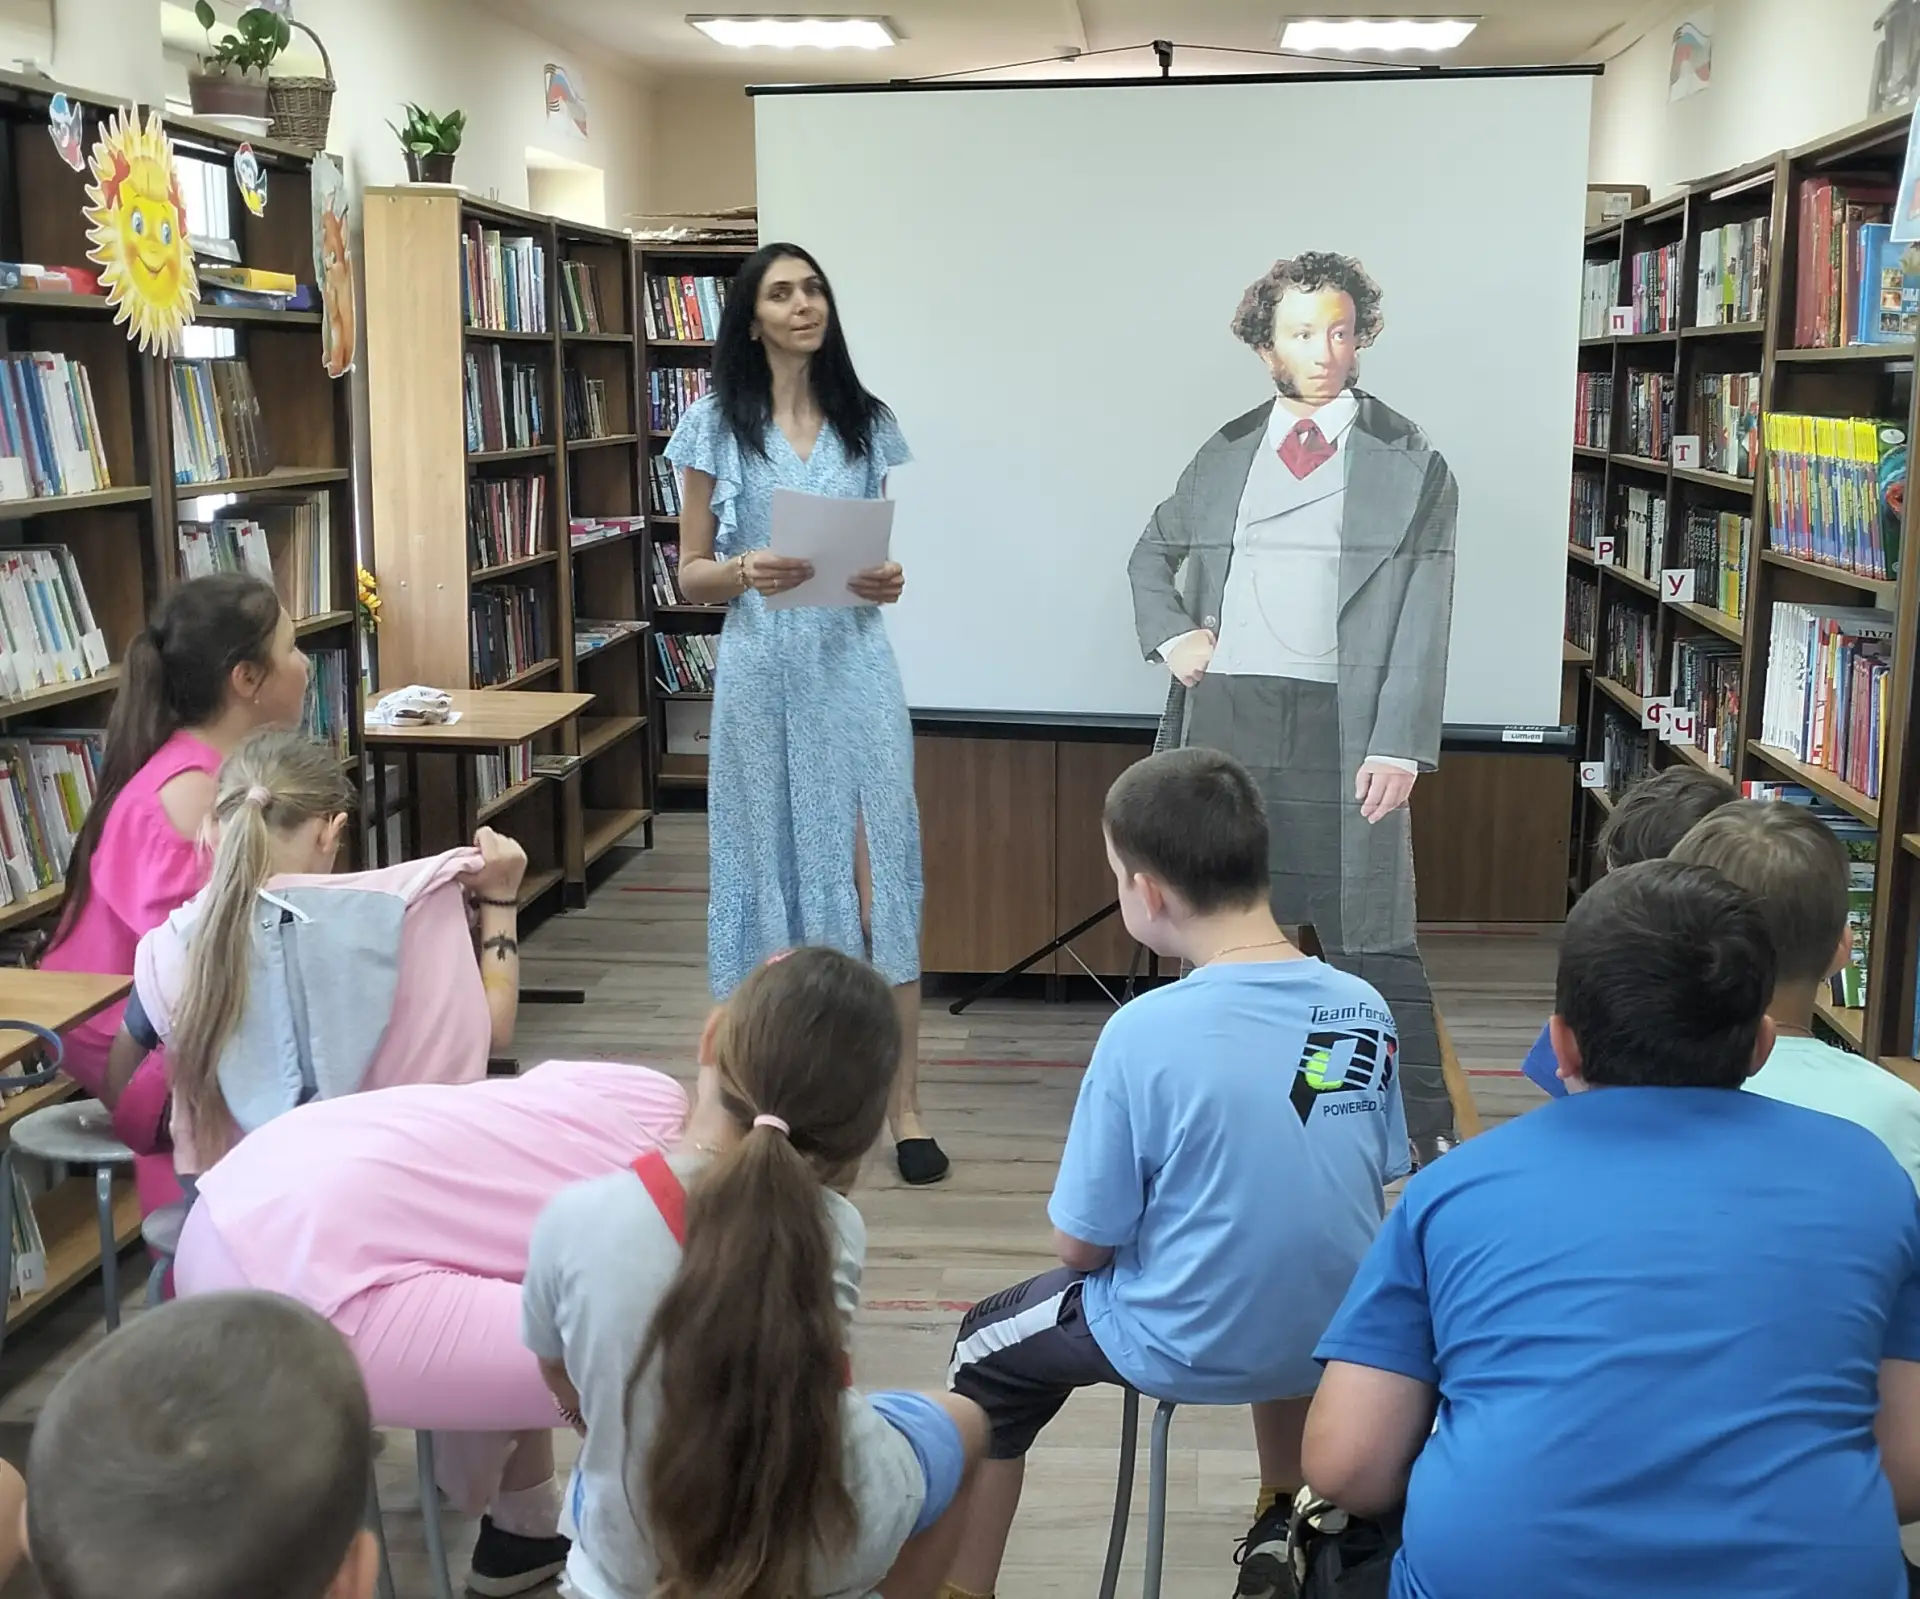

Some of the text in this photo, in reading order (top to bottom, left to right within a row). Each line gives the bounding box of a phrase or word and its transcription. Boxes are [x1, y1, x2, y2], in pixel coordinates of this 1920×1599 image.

[1613, 315, 1624, 329] П
[1675, 444, 1690, 461] Т
[1599, 541, 1614, 560] Р
[1667, 574, 1686, 596] У
[1675, 717, 1693, 739] Ч
[1582, 767, 1596, 781] С
[1323, 1100, 1377, 1117] POWERED
